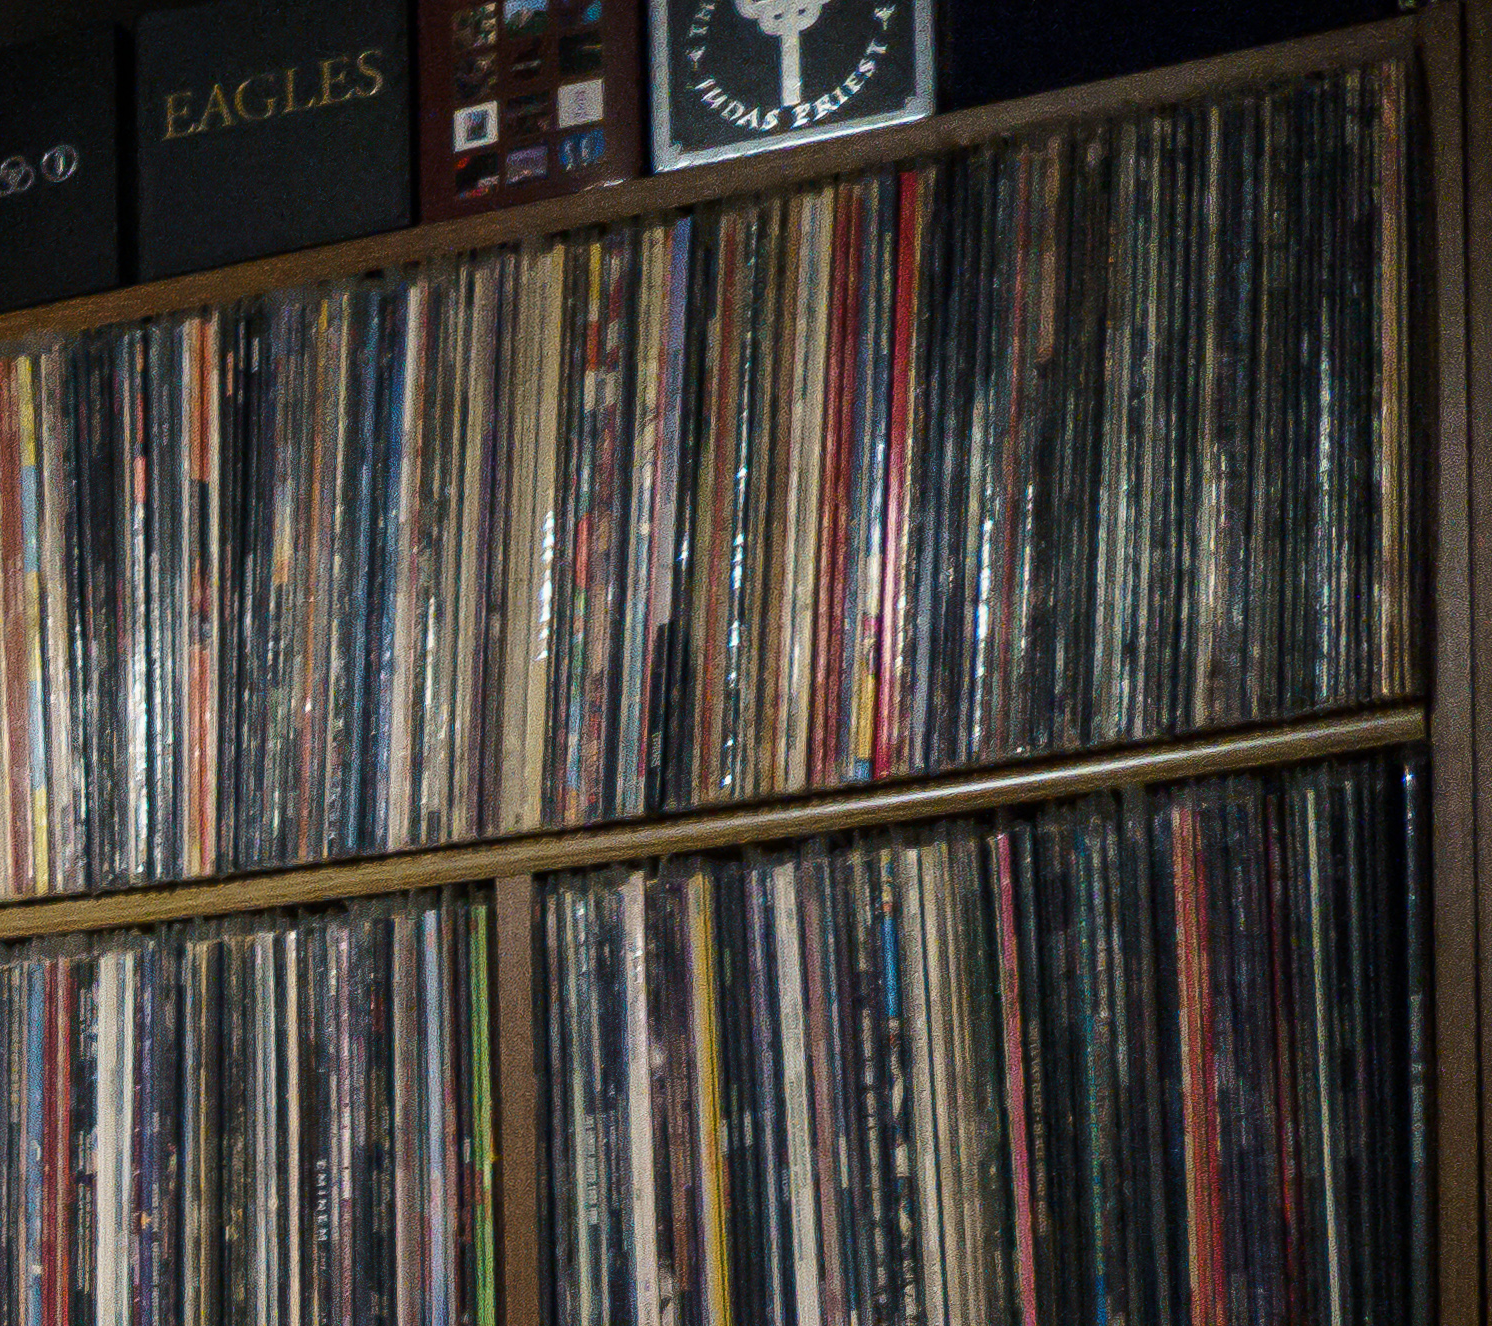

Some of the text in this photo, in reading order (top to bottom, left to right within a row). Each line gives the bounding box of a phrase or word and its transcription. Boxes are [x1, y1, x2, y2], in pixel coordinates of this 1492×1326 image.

[162, 48, 384, 141] EAGLES
[687, 39, 888, 132] JUDAS PRIEST
[315, 1159, 328, 1242] EMINEM
